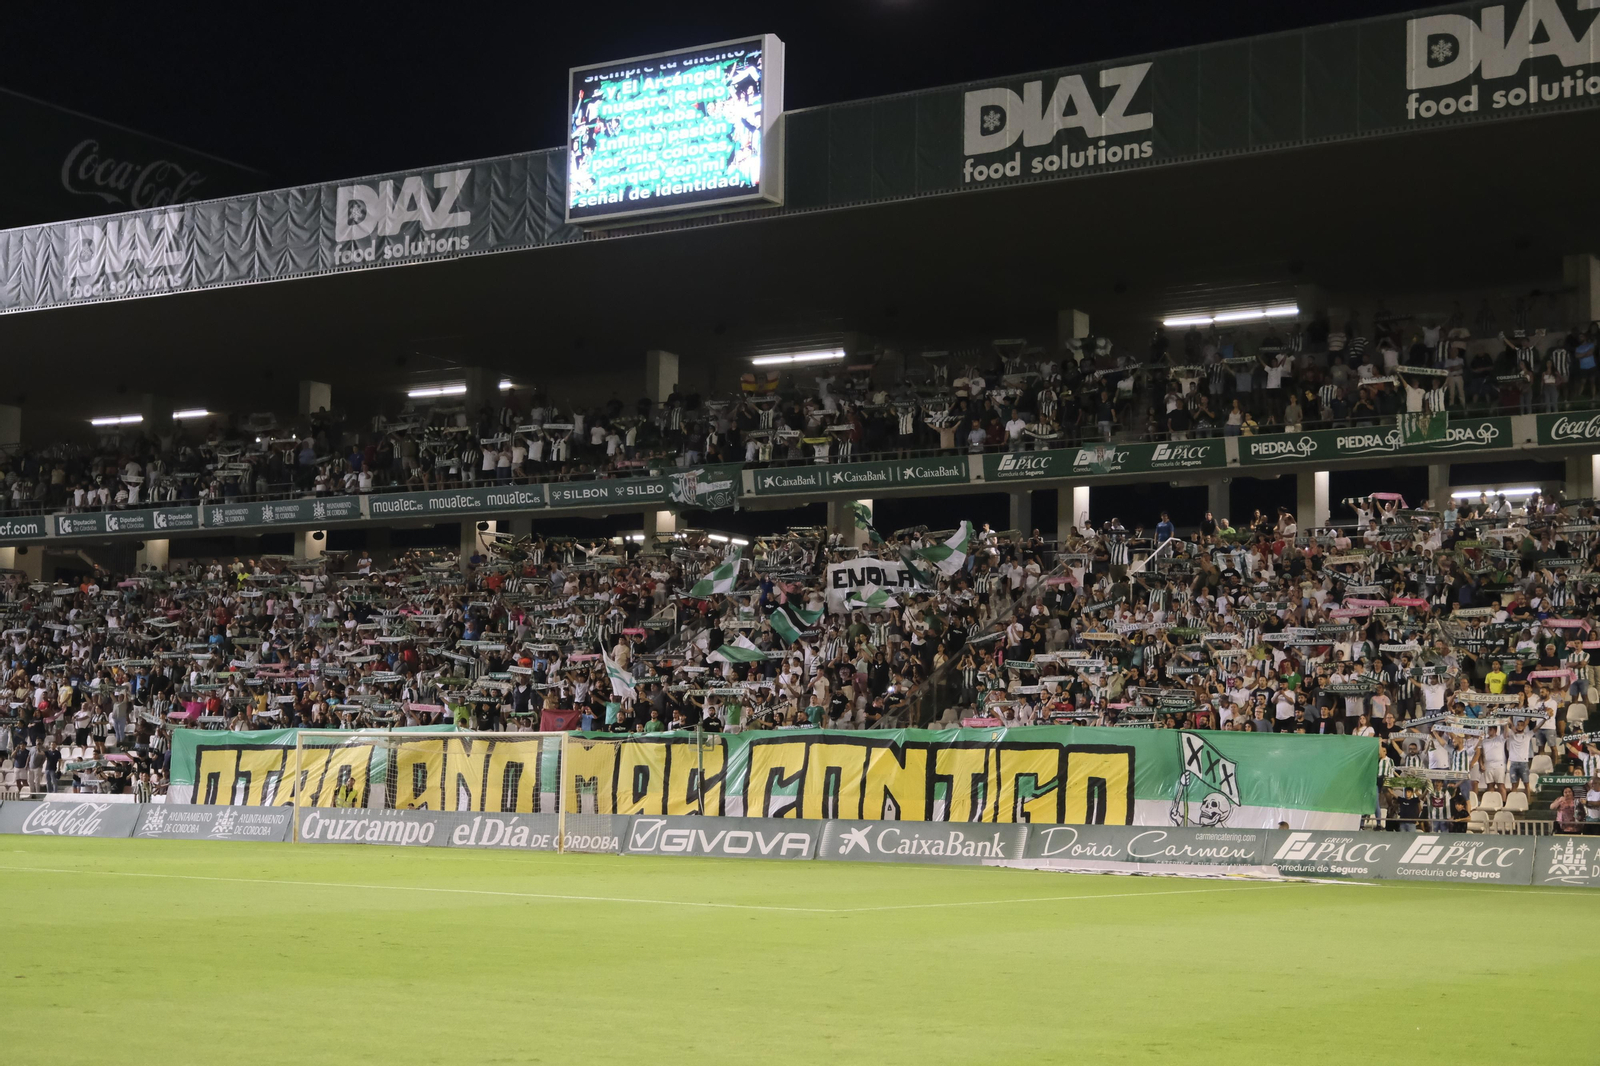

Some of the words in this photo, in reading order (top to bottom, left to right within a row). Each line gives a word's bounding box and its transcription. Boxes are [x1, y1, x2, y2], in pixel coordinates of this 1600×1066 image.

[605, 86, 618, 99] y
[622, 82, 638, 95] El
[643, 66, 722, 90] Arcángel
[602, 94, 669, 115] nuestro
[674, 86, 726, 104] Reino
[963, 62, 1153, 156] DIAZ
[1406, 84, 1479, 120] food
[598, 132, 663, 152] Infinita
[669, 122, 728, 143] pasión
[592, 157, 621, 172] por
[627, 150, 657, 168] mis
[963, 155, 1021, 183] food
[1031, 137, 1153, 174] solutions
[61, 138, 207, 209] Coca-Col
[599, 171, 660, 191] porque
[665, 162, 697, 177] son
[703, 157, 725, 172] mi
[578, 190, 624, 208] señal
[629, 185, 650, 201] de
[655, 176, 746, 198] identidad,
[335, 168, 472, 243] DIAZ
[68, 210, 185, 277] DIAZ
[334, 243, 377, 266] food
[383, 232, 470, 261] solutions
[1170, 446, 1210, 460] PACC
[915, 466, 960, 478] CaixaBank
[1014, 456, 1052, 470] PACC
[1181, 459, 1202, 467] Seguros
[775, 475, 816, 487] CaixaBank
[844, 471, 887, 483] CaixaBank
[1025, 469, 1045, 477] Seguros
[563, 488, 608, 500] SILBON
[73, 518, 97, 527] Diputación
[120, 516, 144, 524] Diputación
[168, 513, 193, 521] Diputación
[22, 802, 113, 836] Coca-Cola
[167, 812, 213, 822] AYUNTAMIENTO
[237, 813, 285, 824] AYUNTAMIENTO
[163, 823, 171, 832] DE
[233, 825, 242, 834] DE
[301, 810, 436, 846] Cruzcampo
[531, 833, 548, 847] DE
[553, 832, 619, 850] CÓRDOBA
[660, 828, 811, 856] GIVOVA
[877, 827, 1005, 858] CaixaBank
[1041, 827, 1121, 858] Doña
[1127, 830, 1255, 858] Carmen
[1195, 832, 1256, 844] carmencatering.com
[1453, 840, 1485, 848] GRUPO
[1308, 842, 1392, 863] PACC
[1440, 846, 1525, 868] PACC
[1271, 862, 1316, 874] Correduría
[1316, 864, 1328, 873] de
[1330, 865, 1368, 875] Seguros
[1396, 867, 1441, 878] Correduría
[1443, 869, 1458, 877] de
[1459, 869, 1501, 879] Seguros
